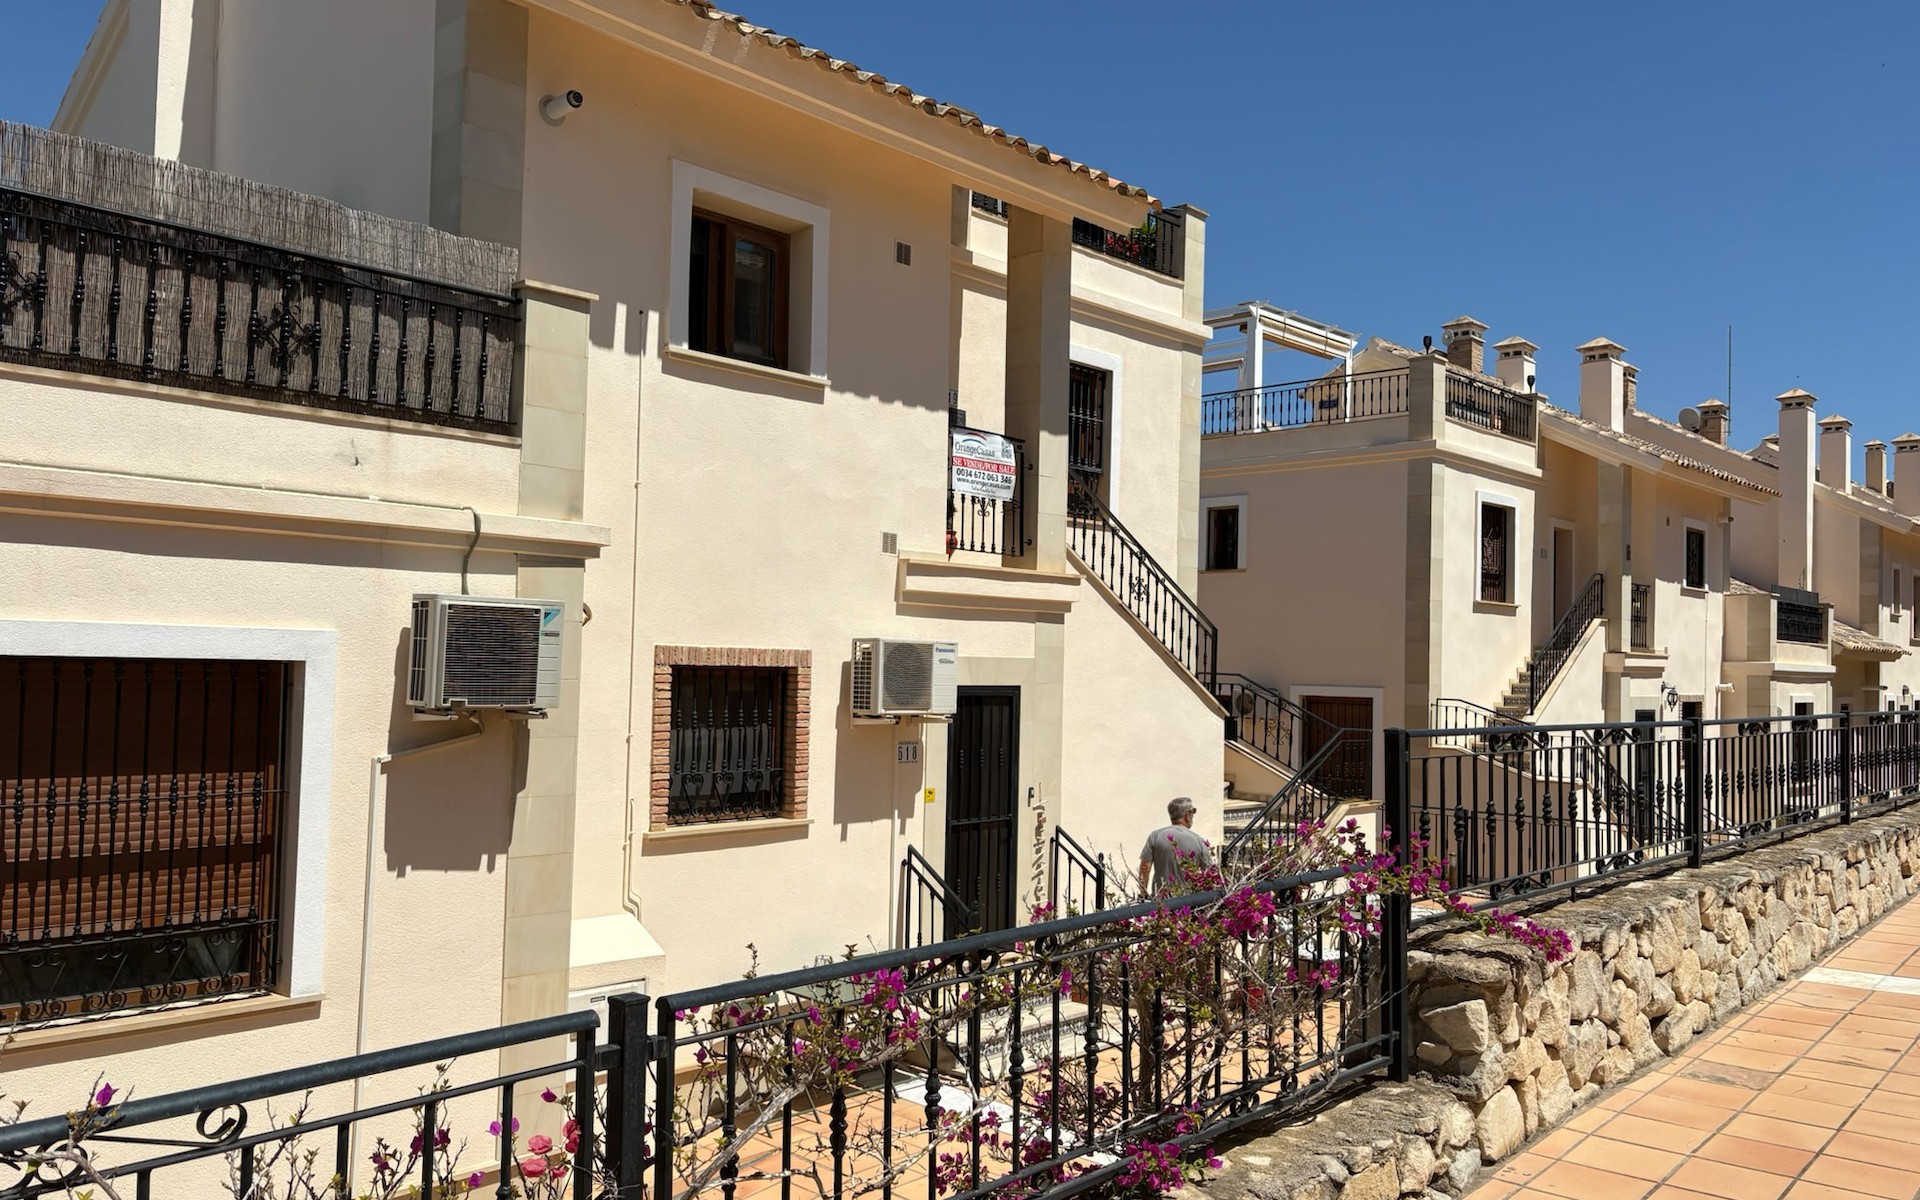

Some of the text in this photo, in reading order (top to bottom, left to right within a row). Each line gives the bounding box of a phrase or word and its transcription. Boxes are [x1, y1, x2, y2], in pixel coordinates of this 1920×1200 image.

[955, 442, 996, 457] OrangeCasas
[953, 457, 963, 466] SE
[963, 459, 998, 473] VENDE/FOR
[998, 466, 1016, 475] SALE
[956, 468, 1012, 484] 0034 672 063 346
[956, 478, 1011, 490] www.orangecasas.com
[898, 745, 918, 760] 618
